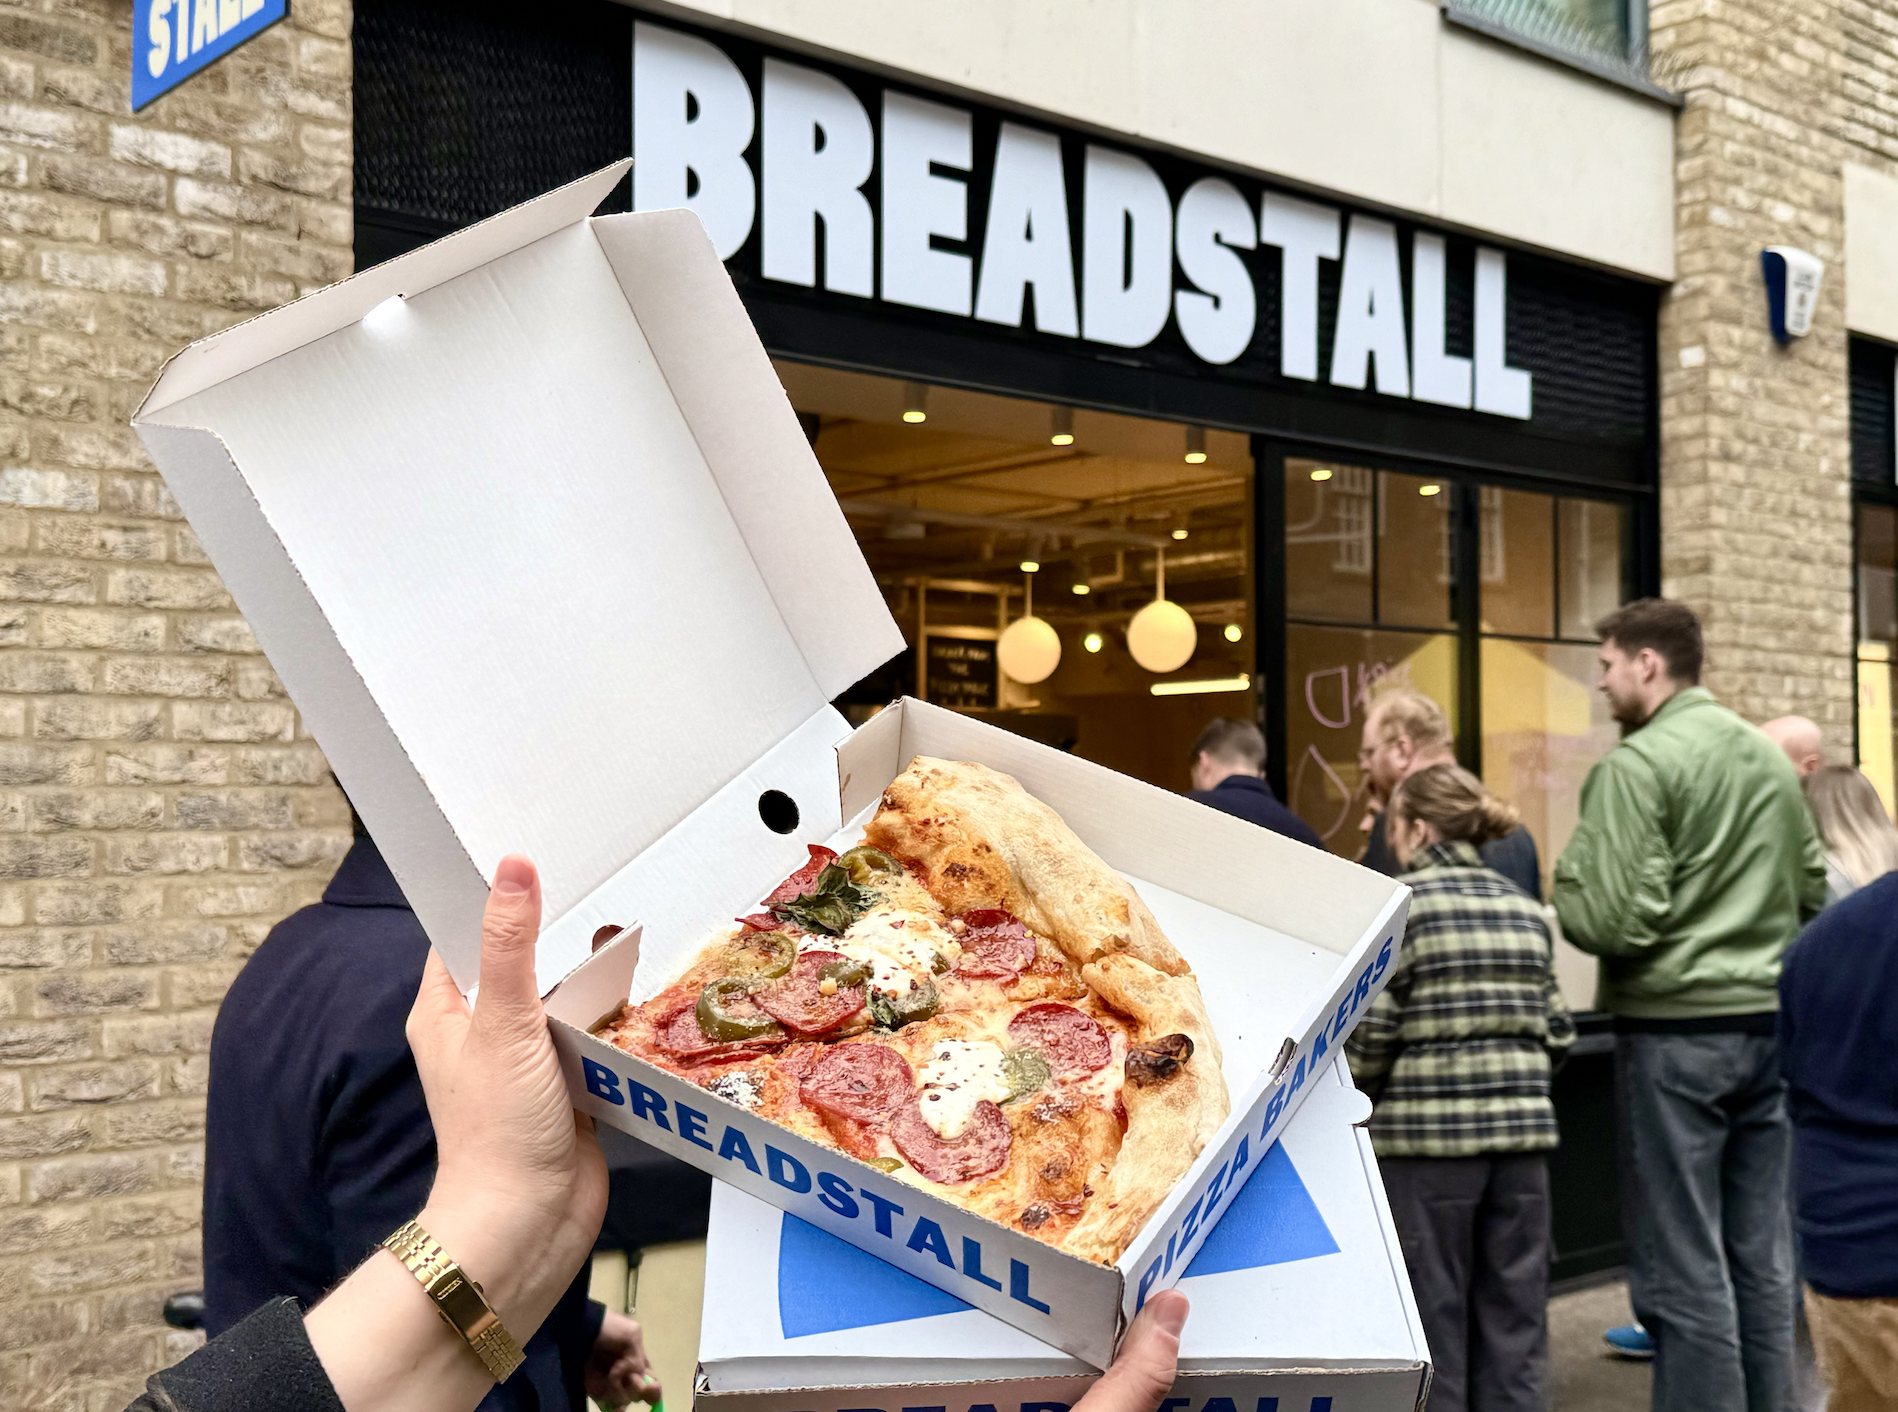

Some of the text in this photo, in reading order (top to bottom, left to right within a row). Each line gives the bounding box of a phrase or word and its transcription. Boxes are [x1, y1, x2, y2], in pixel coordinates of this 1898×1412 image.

[632, 19, 1532, 420] BREADSTALL
[582, 1056, 1050, 1314] BREADSTALL
[1135, 936, 1393, 1317] PIZZA BAKERS
